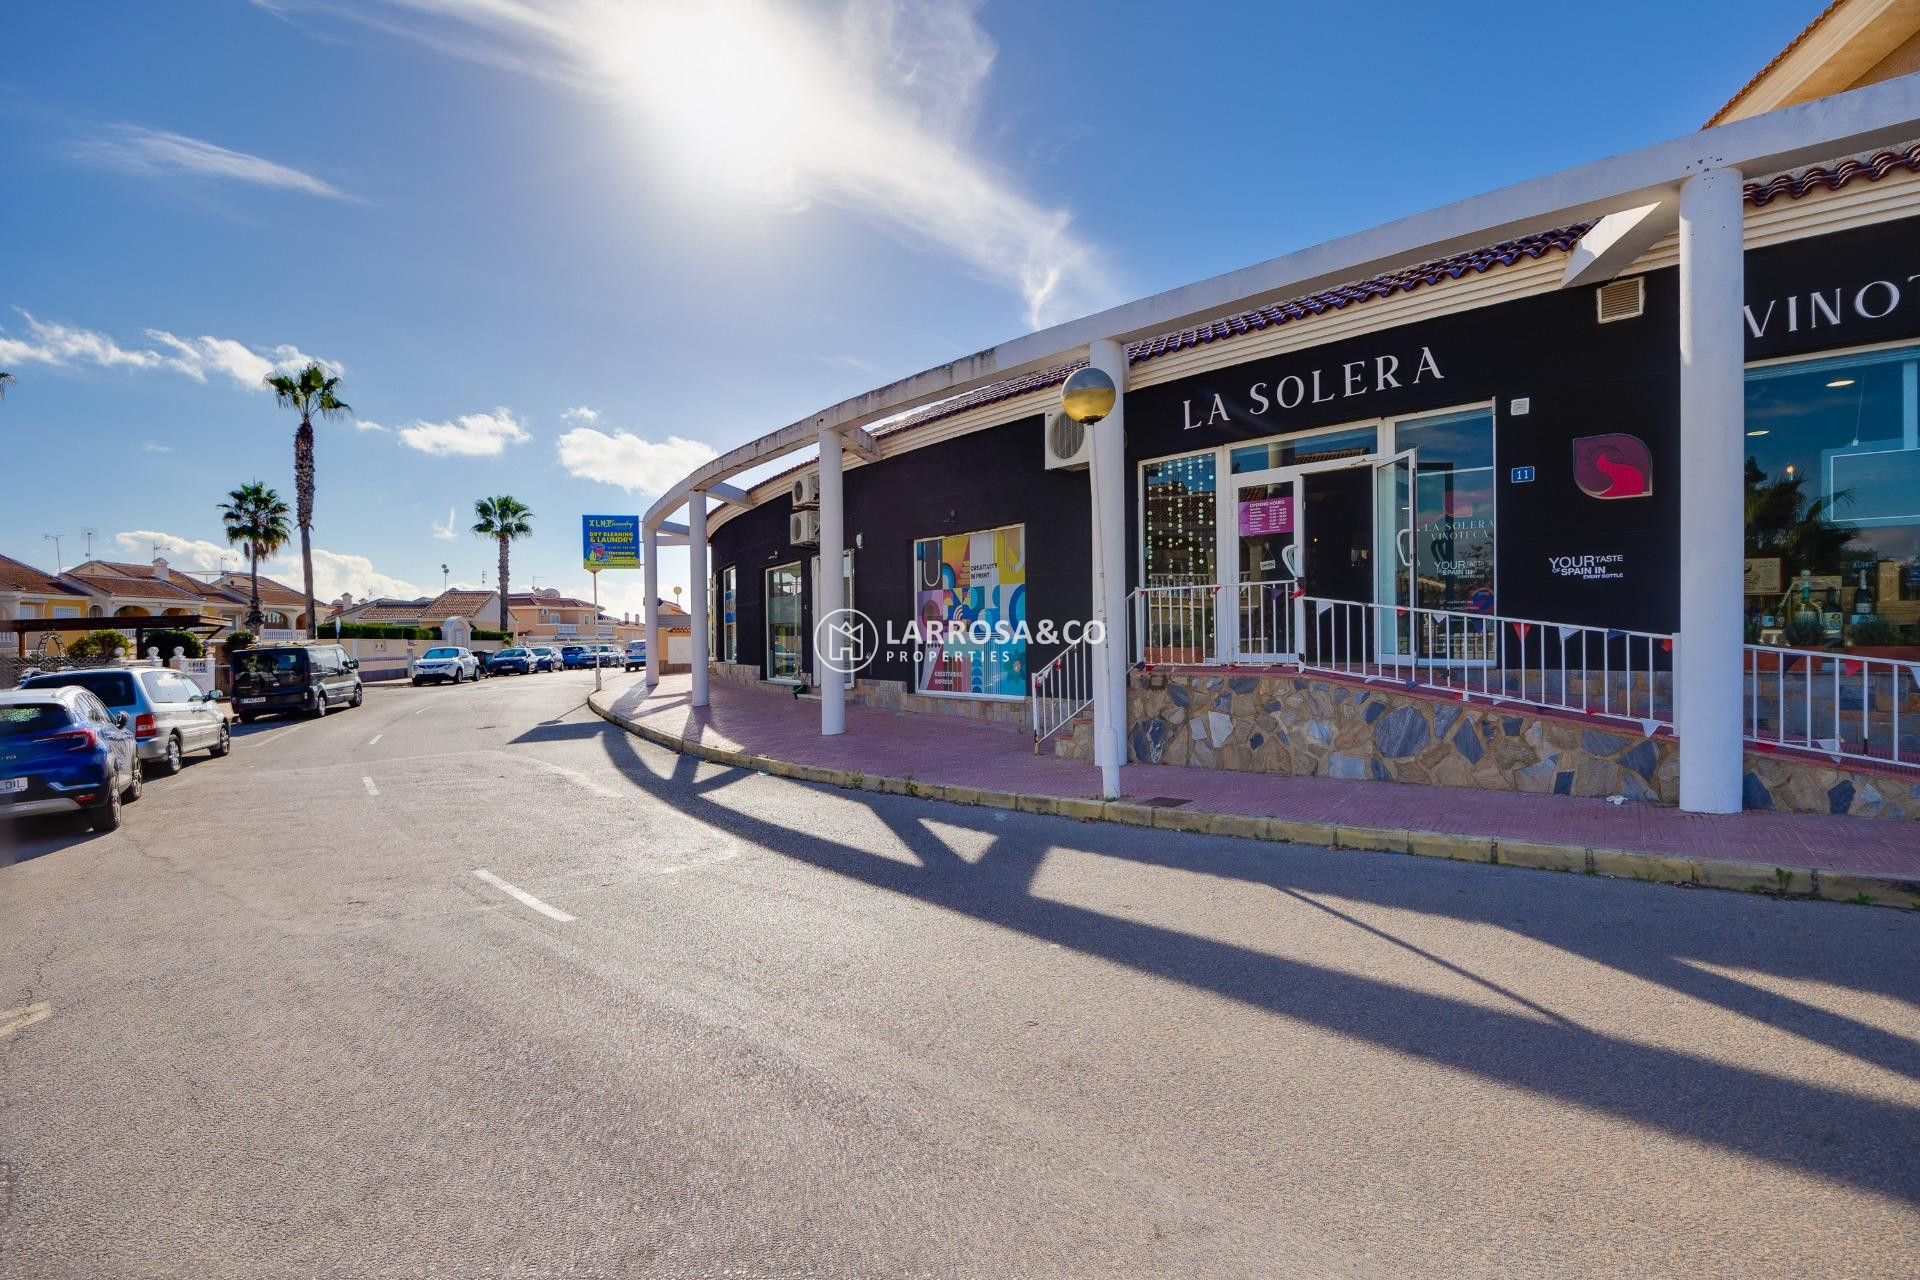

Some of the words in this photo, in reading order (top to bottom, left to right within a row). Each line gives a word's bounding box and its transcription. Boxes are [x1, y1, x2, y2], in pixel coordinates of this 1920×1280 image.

[1183, 393, 1231, 430] LA
[1249, 346, 1445, 416] SOLERA
[1516, 470, 1529, 480] 11
[1445, 519, 1494, 531] SOLERA
[1434, 560, 1466, 570] YOUR
[1548, 555, 1595, 569] YOUR
[1595, 554, 1624, 563] TASTE
[970, 563, 998, 572] CREATIVITY
[1561, 567, 1592, 576] SPAIN
[1594, 566, 1606, 574] IN
